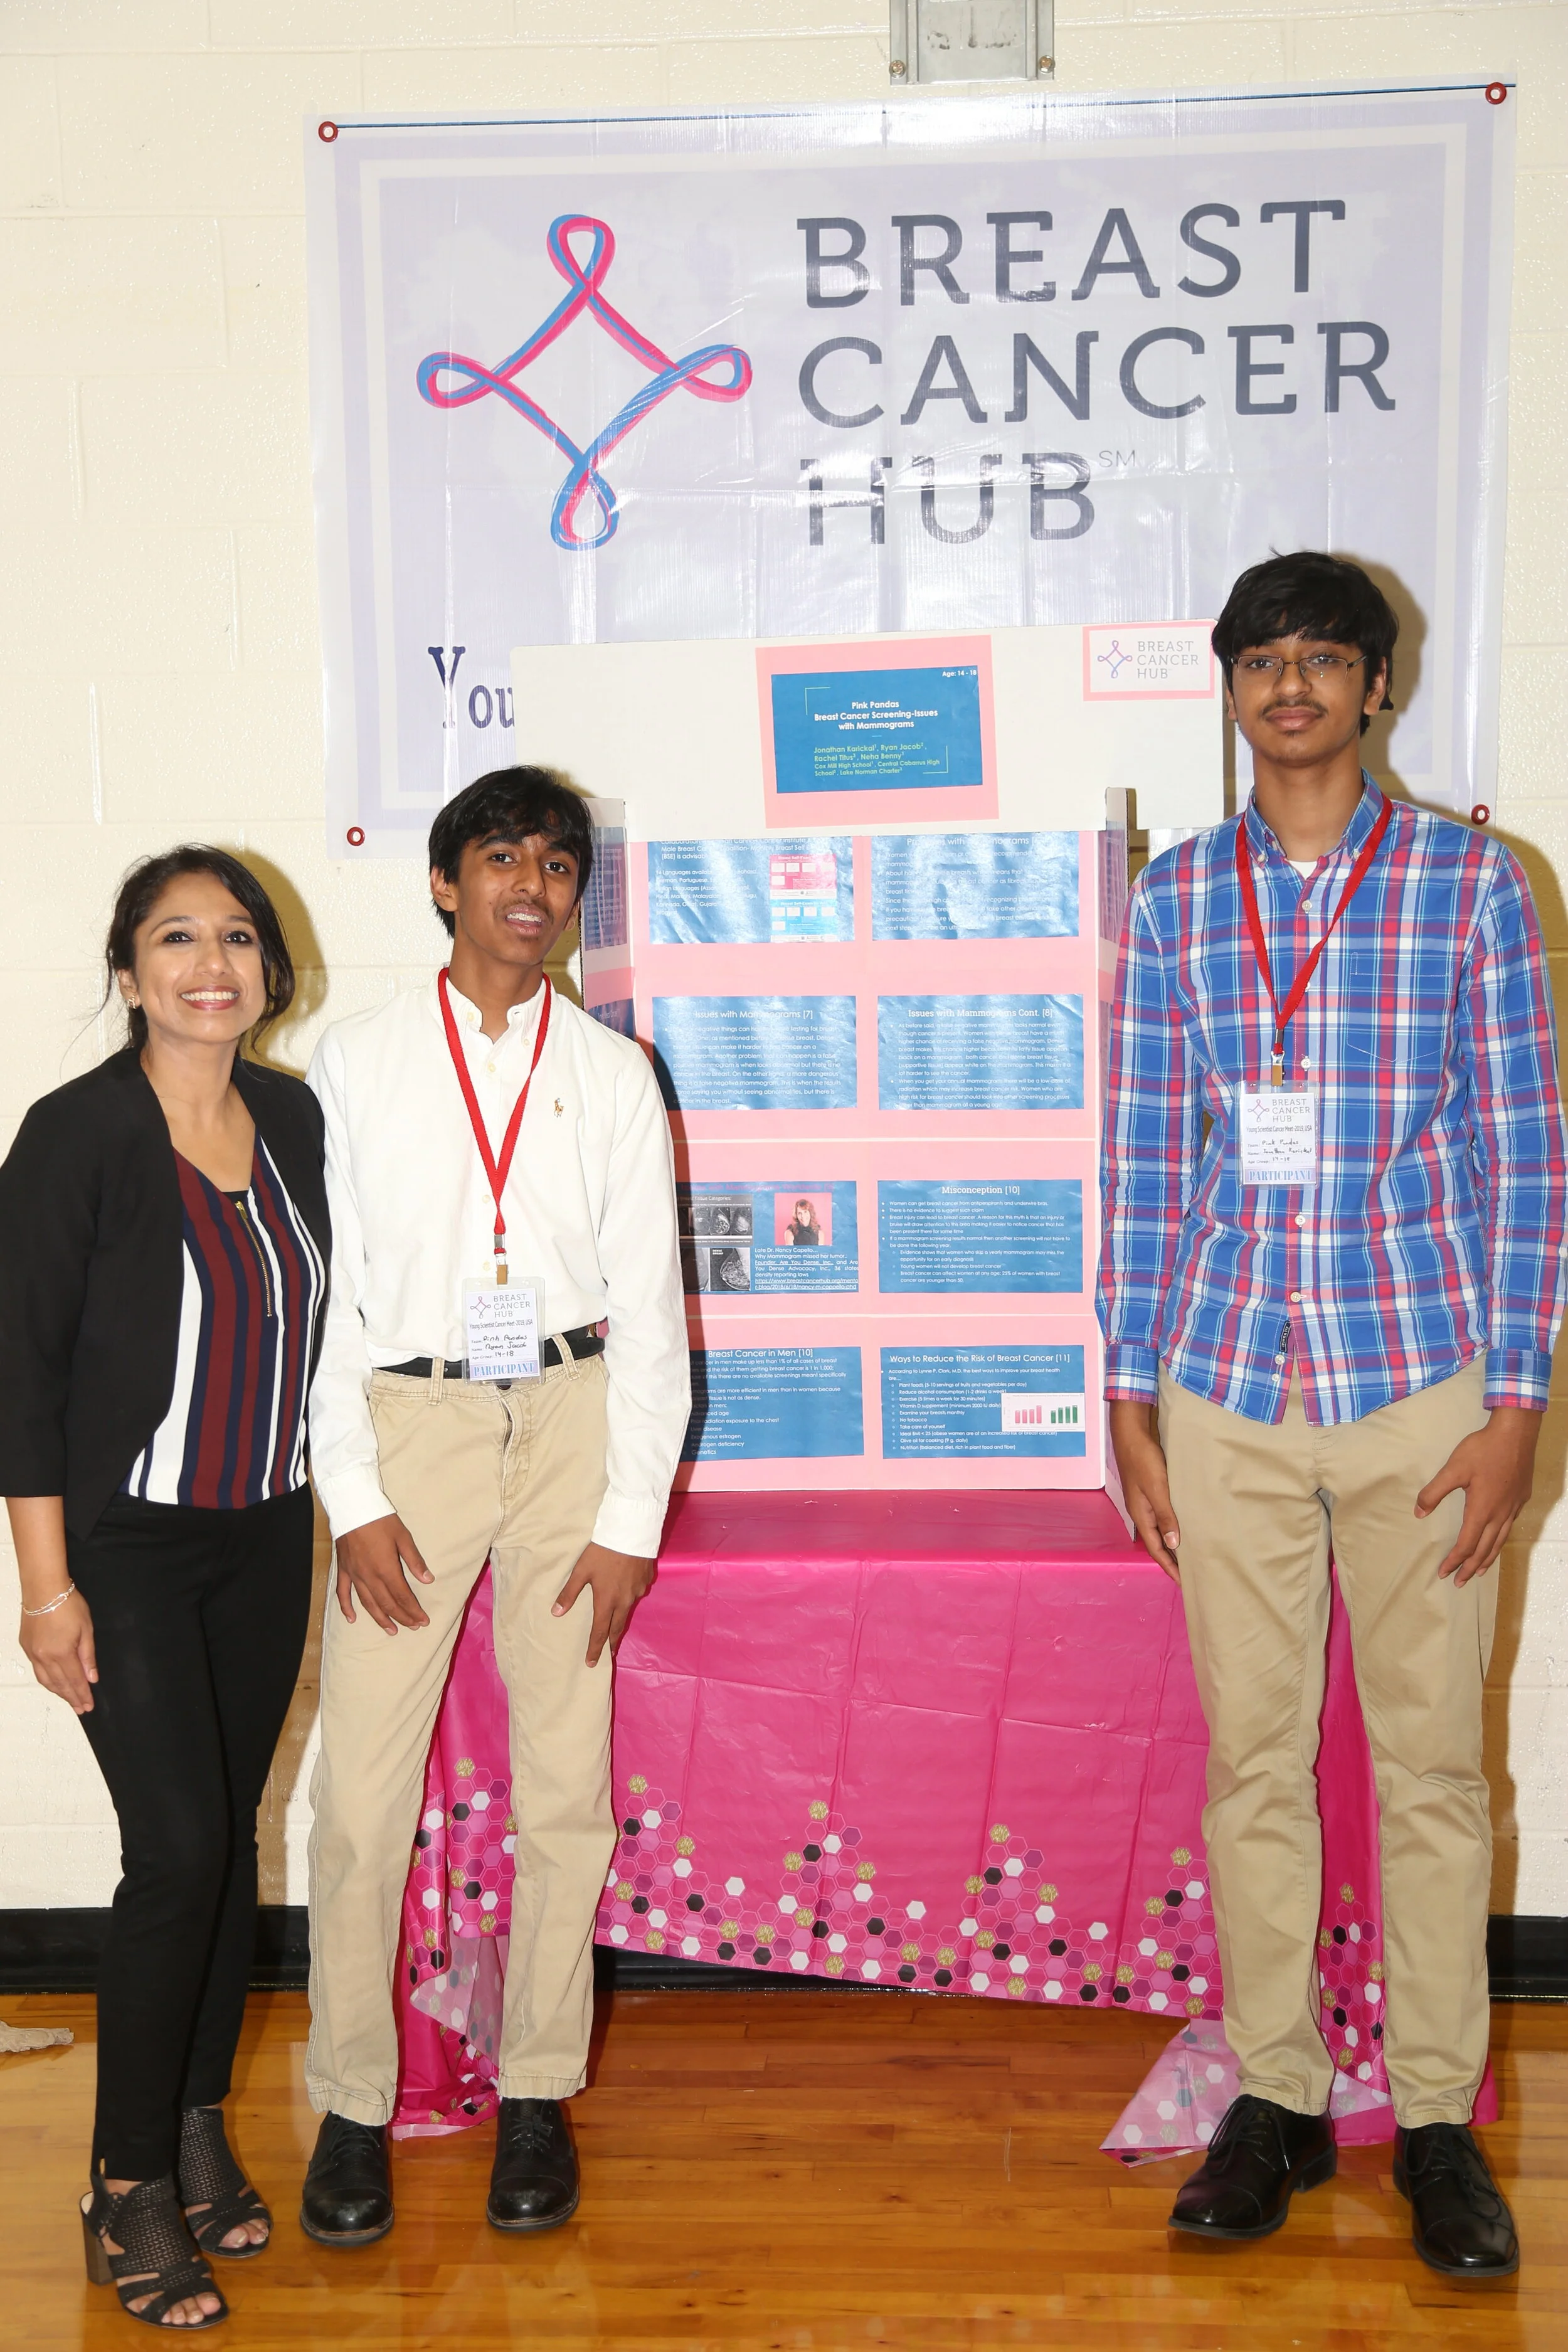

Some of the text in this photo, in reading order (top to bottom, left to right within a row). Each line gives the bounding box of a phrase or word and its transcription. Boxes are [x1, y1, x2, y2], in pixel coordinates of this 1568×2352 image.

[797, 199, 1346, 309] BREAST
[798, 320, 1396, 428] CANCER
[800, 452, 1095, 546] HUB
[1137, 641, 1194, 652] BREAST
[1137, 654, 1199, 665] CANCER
[942, 670, 956, 678] Age:
[1137, 668, 1168, 679] HUB
[869, 701, 899, 709] Pandas
[840, 712, 869, 720] Cancer
[872, 709, 938, 721] Screening-Issues
[856, 721, 914, 731] Mammograms
[739, 1010, 800, 1020] Mamograms
[803, 1010, 813, 1019] [7]
[1042, 1009, 1053, 1017] [8]
[1249, 1170, 1311, 1181] PARTICIPANT
[941, 1186, 1020, 1195] Misconception [10]
[494, 1293, 527, 1302] BREAST
[494, 1301, 530, 1310] CANCER
[798, 1349, 813, 1358] [10]
[889, 1355, 911, 1364] Ways
[1055, 1354, 1070, 1362] [11]
[474, 1362, 534, 1376] PARTICIPANT
